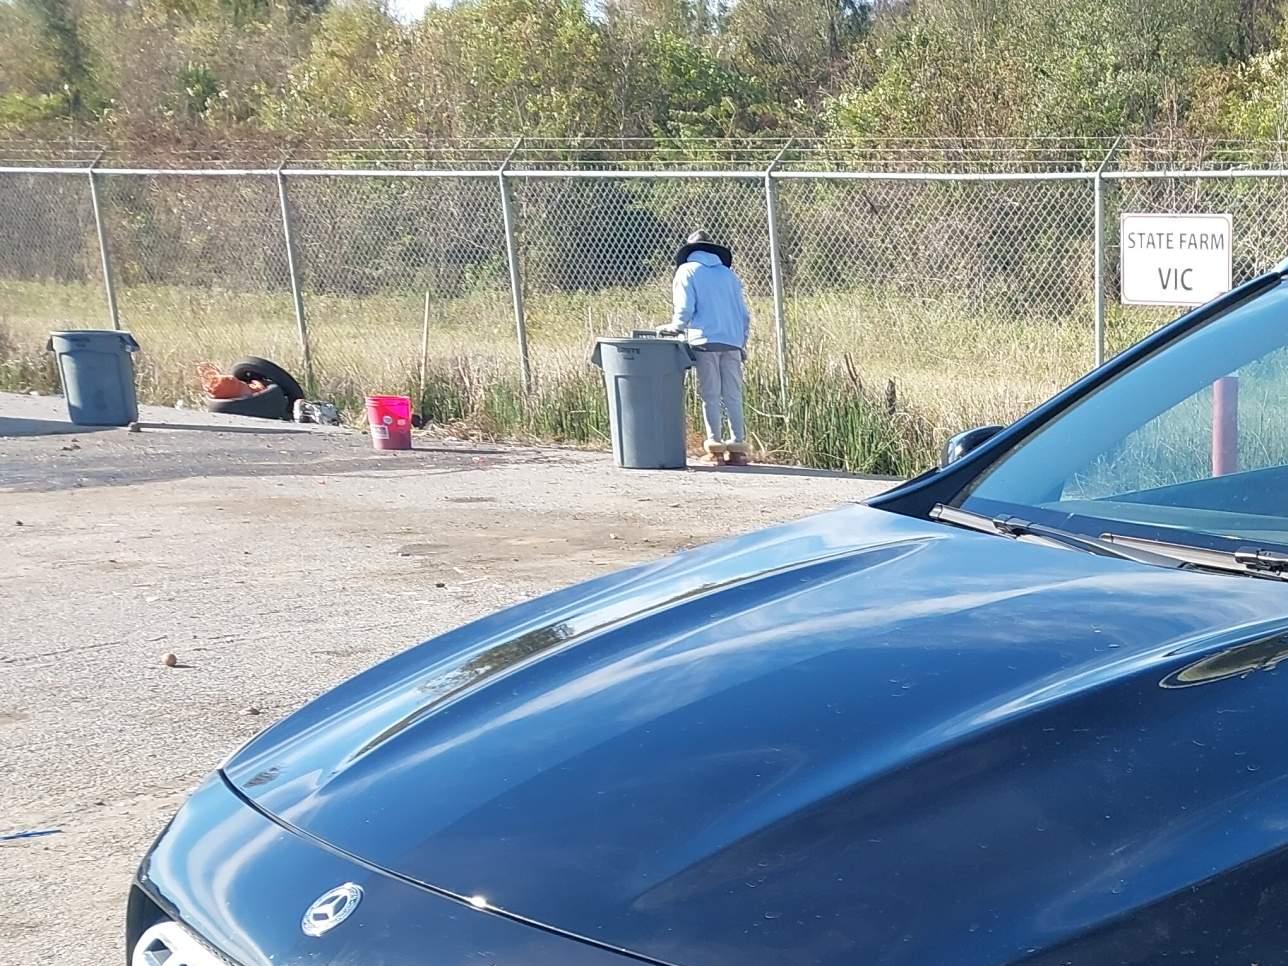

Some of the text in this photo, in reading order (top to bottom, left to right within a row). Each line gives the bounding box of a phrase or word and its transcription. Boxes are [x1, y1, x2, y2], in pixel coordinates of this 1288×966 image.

[1127, 231, 1225, 251] STATE FARM
[1157, 267, 1193, 291] VIC
